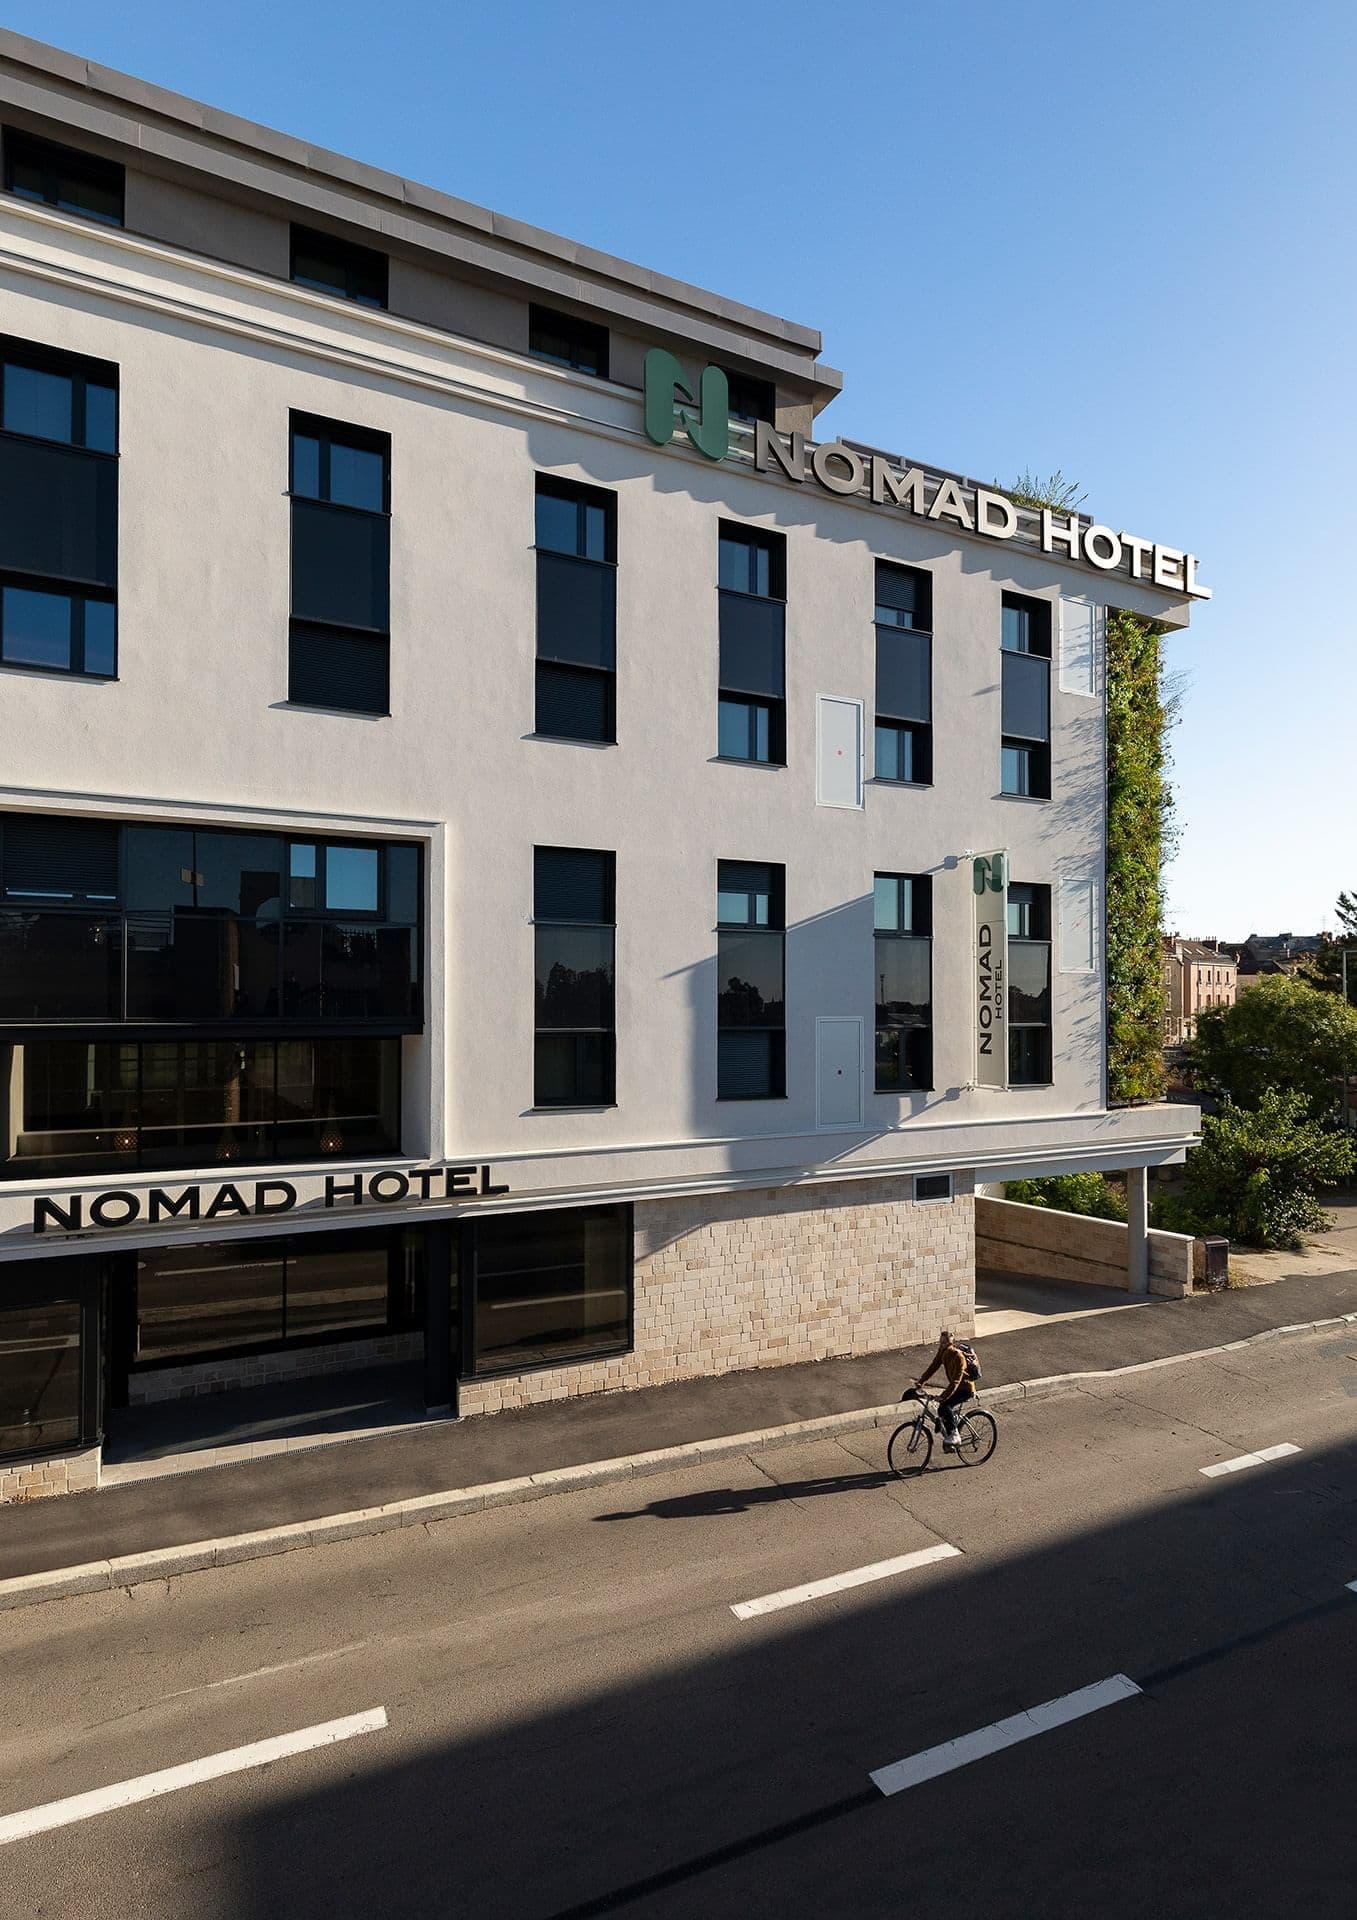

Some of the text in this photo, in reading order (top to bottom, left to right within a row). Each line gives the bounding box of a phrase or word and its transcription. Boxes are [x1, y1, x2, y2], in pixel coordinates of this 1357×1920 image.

[754, 419, 1212, 600] NOMAD HOTEL
[979, 924, 992, 1055] NOMAD
[995, 959, 1003, 1019] HOTEL
[33, 1165, 509, 1233] NOMAD HOTEL
